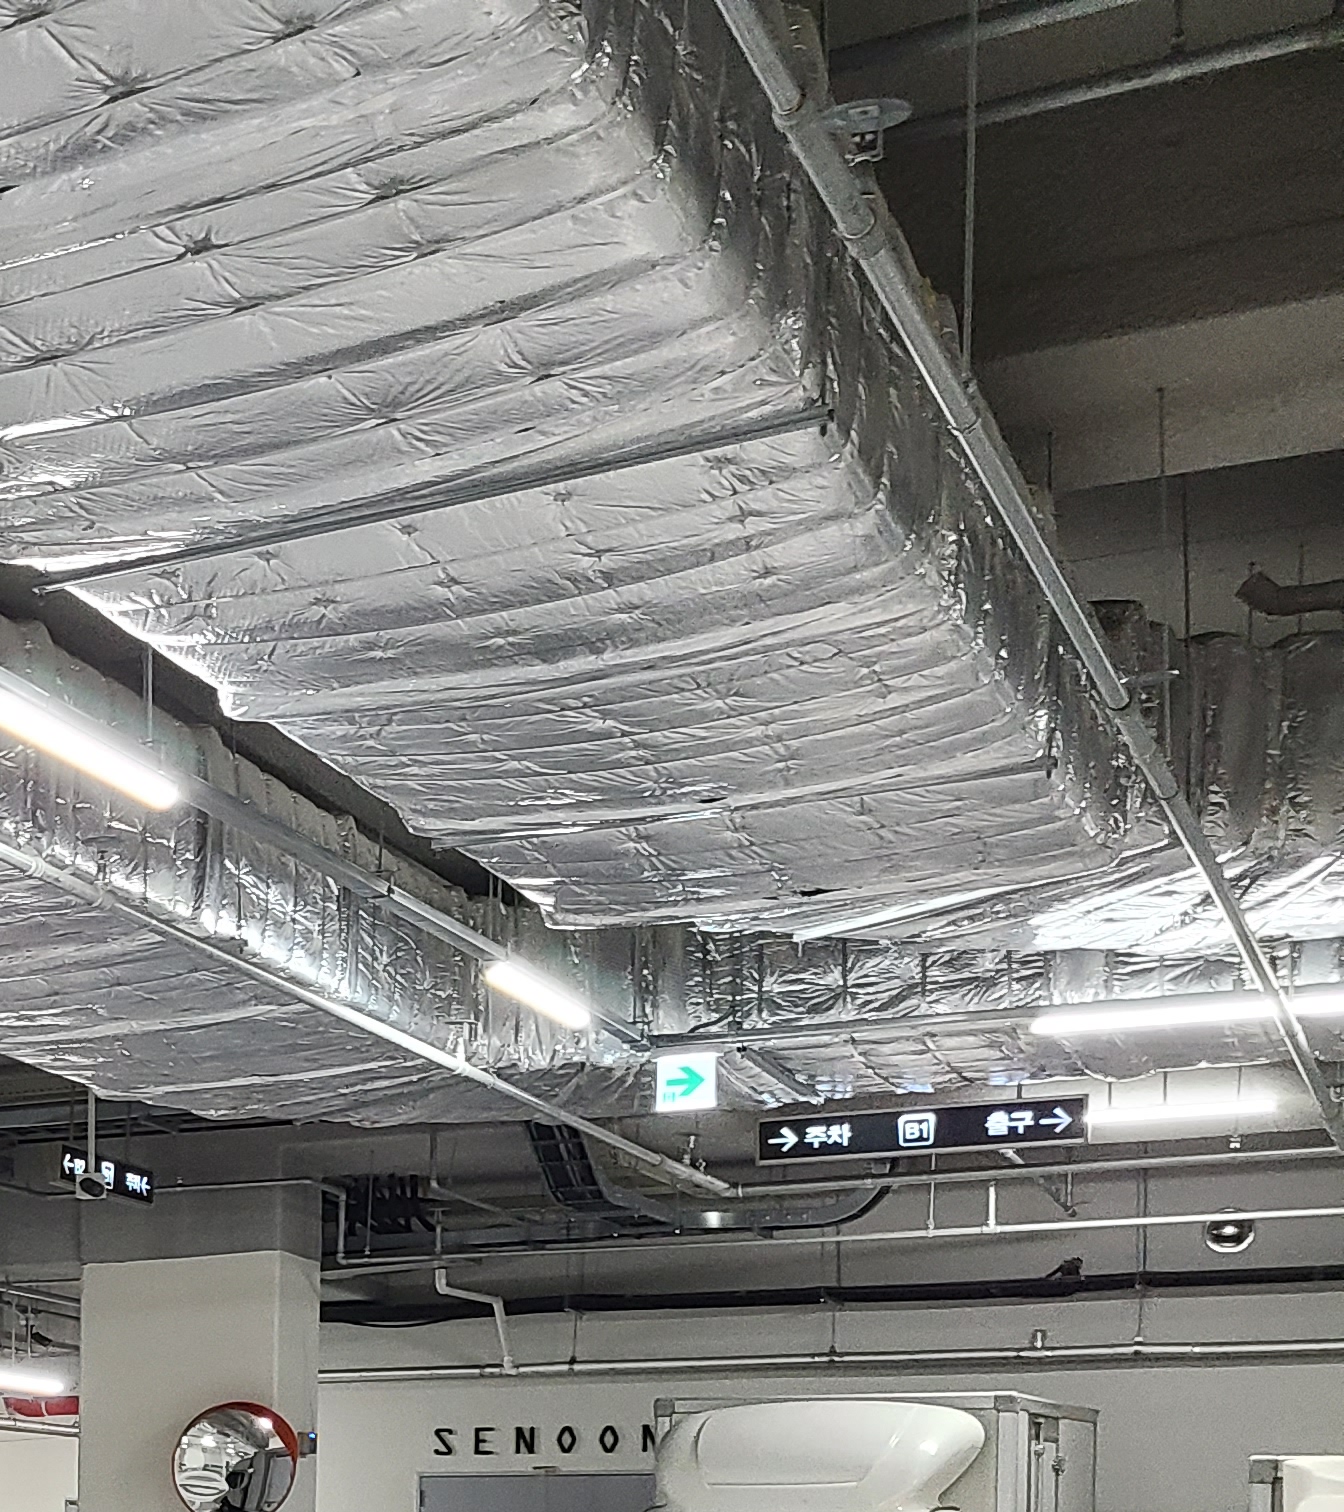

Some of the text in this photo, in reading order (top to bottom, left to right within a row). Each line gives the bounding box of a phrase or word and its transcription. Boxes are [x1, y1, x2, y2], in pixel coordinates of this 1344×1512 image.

[803, 1122, 852, 1148] 주차
[905, 1121, 929, 1140] B1
[984, 1110, 1034, 1136] 출구
